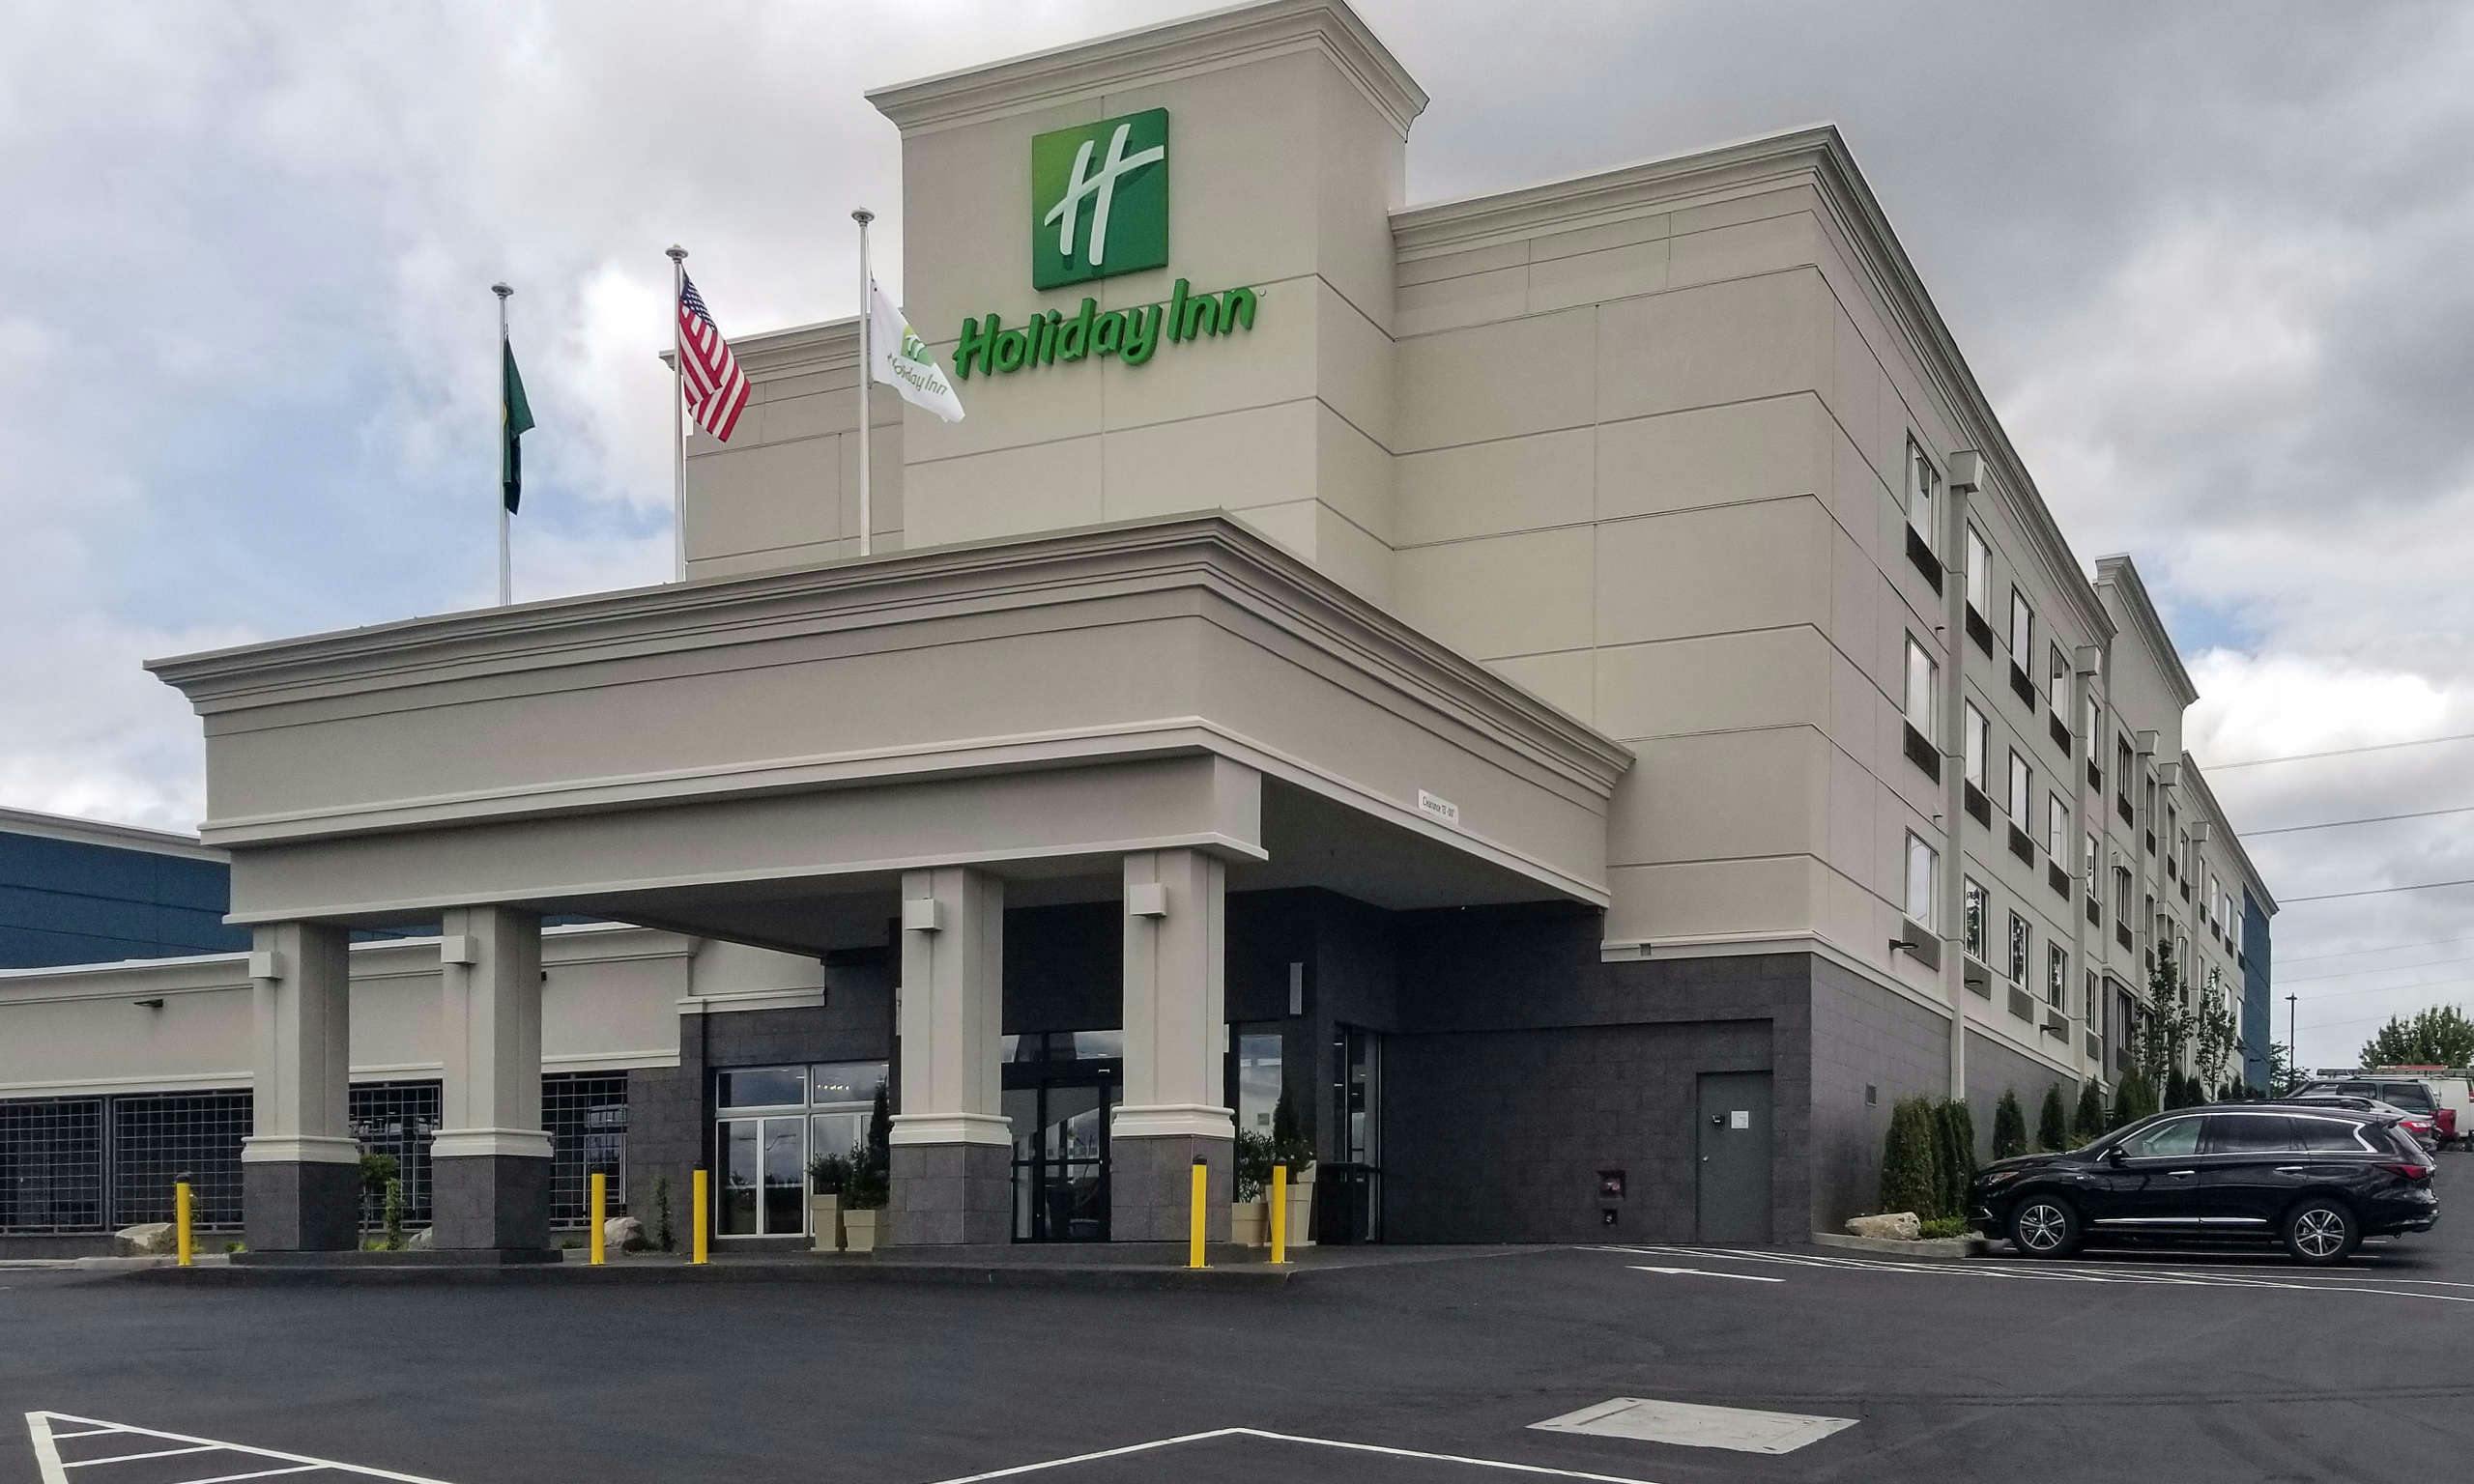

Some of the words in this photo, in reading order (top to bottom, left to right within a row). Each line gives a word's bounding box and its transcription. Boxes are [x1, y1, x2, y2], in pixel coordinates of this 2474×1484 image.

[953, 298, 1163, 380] Holiday
[1166, 277, 1258, 343] Inn
[925, 374, 948, 395] Inn
